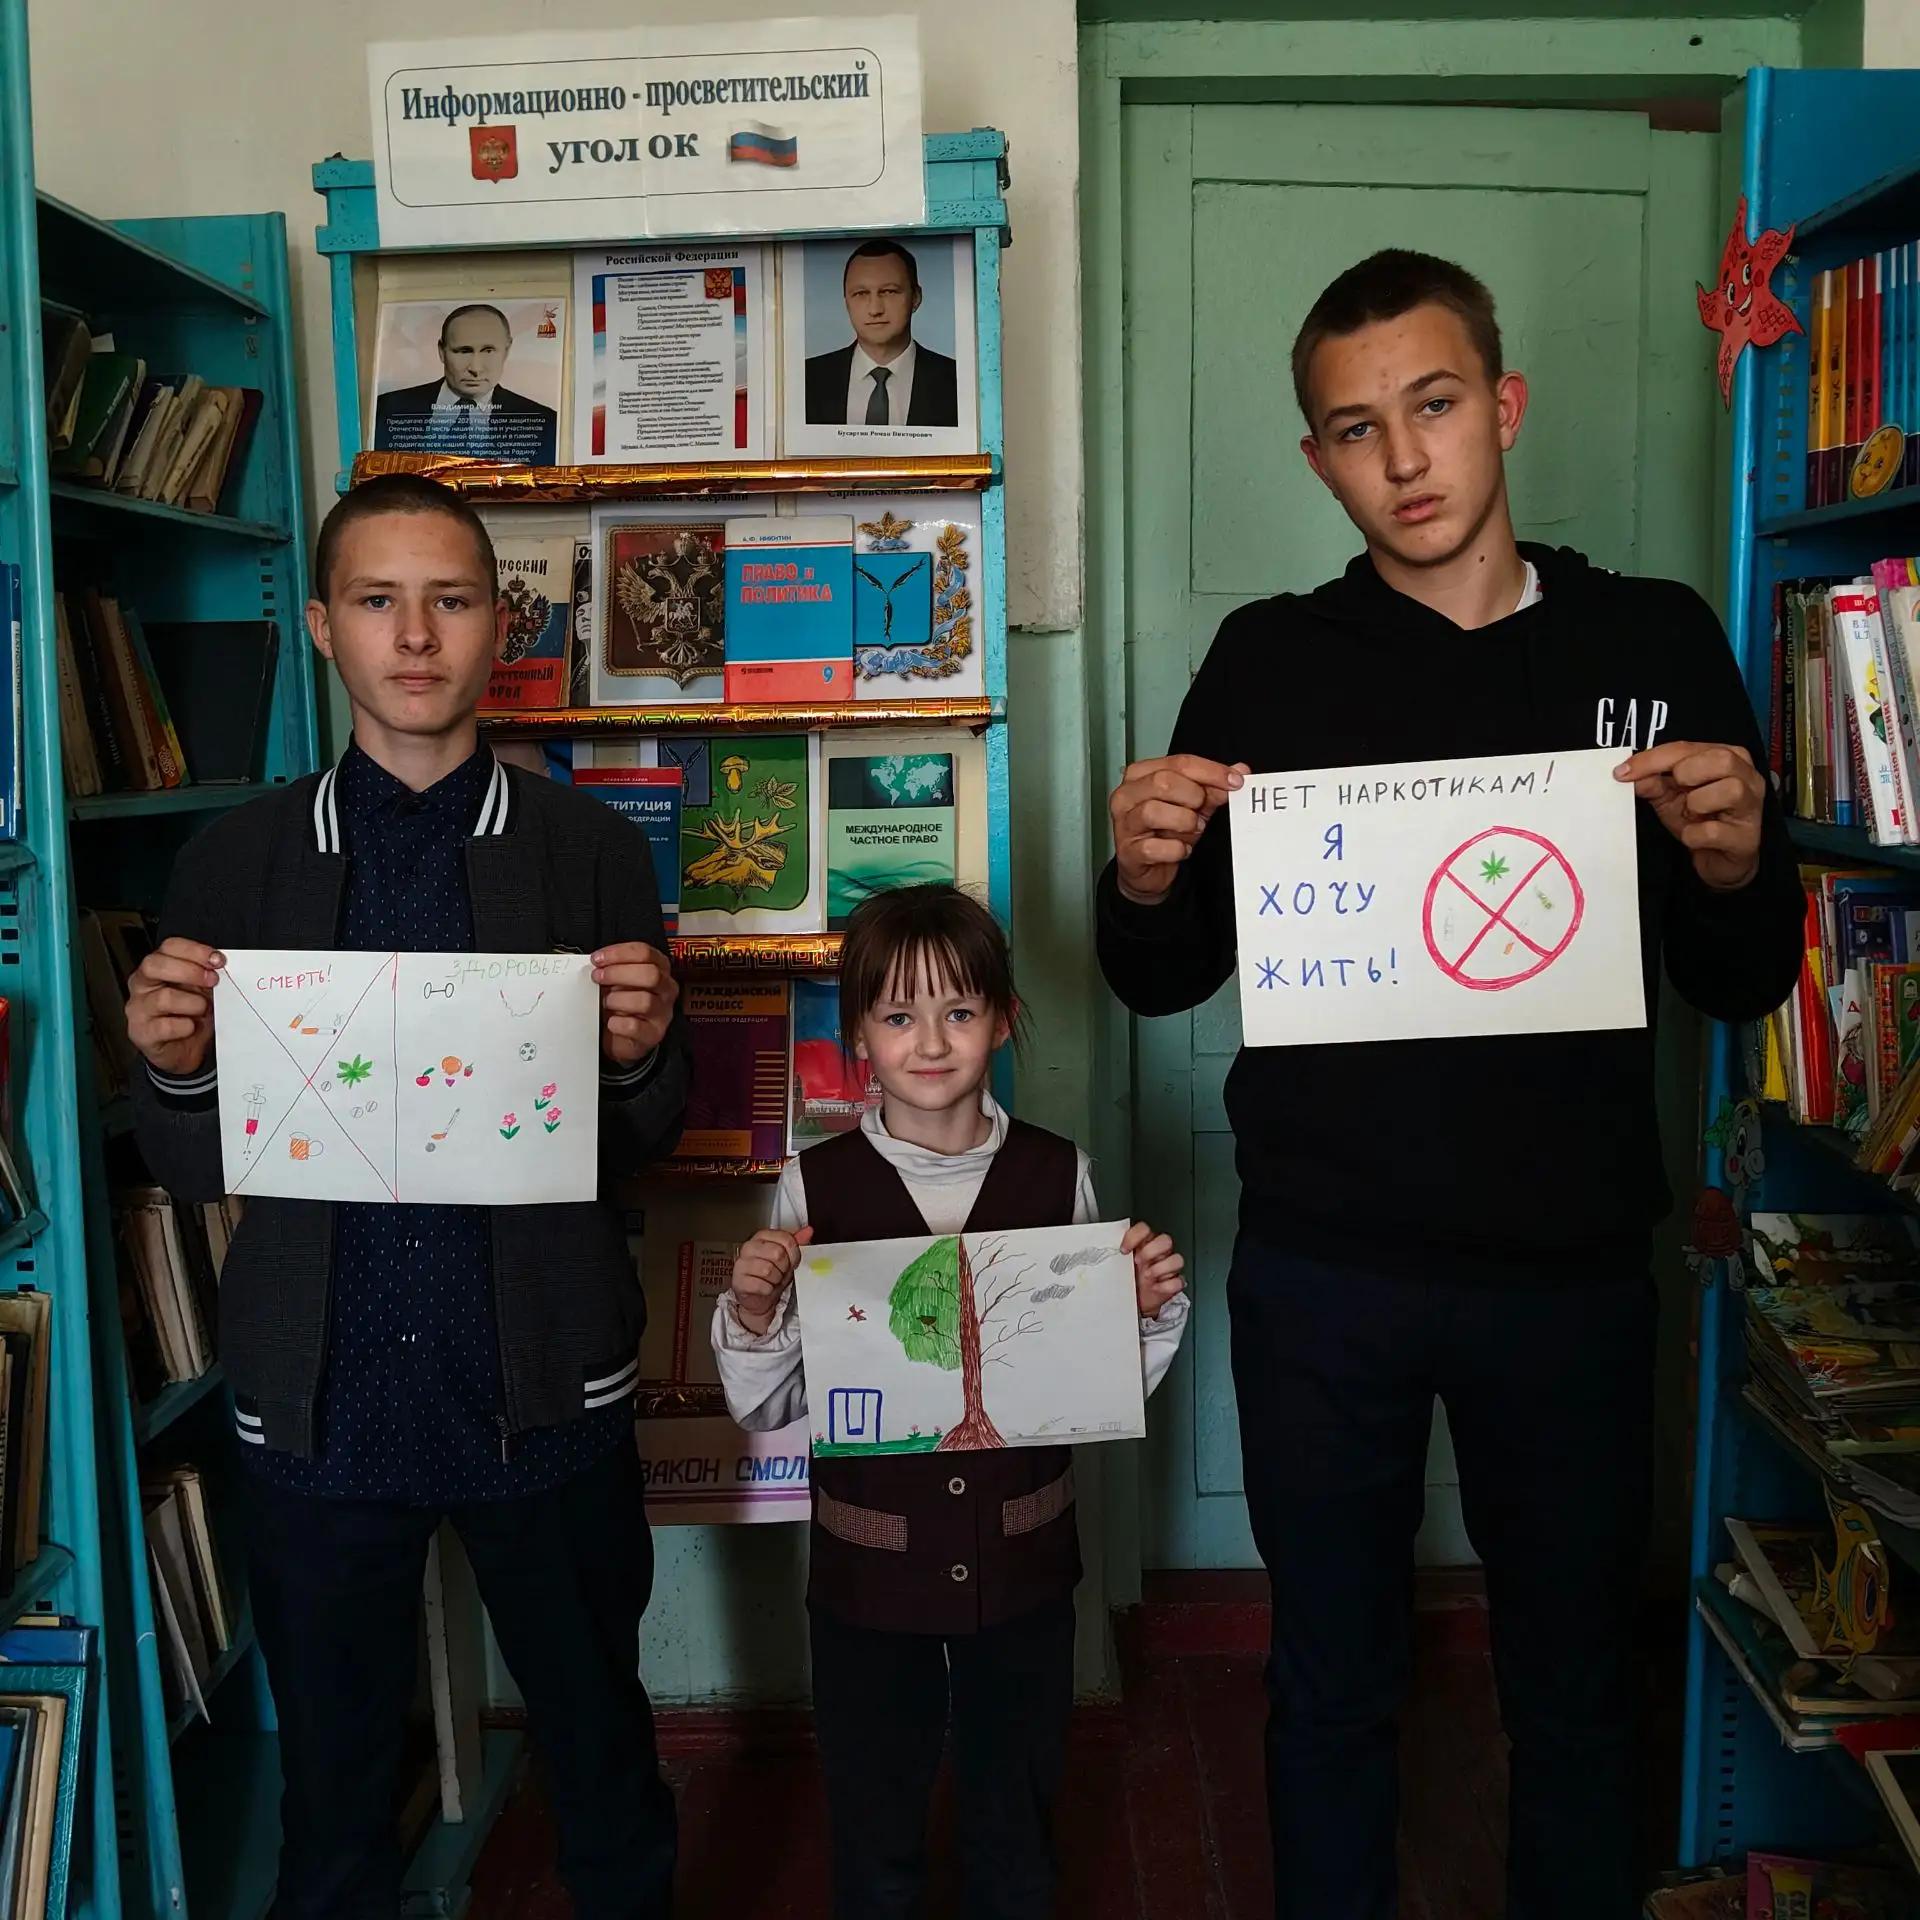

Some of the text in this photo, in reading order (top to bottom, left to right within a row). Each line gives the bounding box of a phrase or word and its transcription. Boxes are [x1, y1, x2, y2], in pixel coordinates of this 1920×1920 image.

[401, 84, 627, 127] Информационно
[645, 60, 870, 116] просветительский
[605, 250, 739, 266] Российской Федерации
[431, 402, 474, 413] Владимир
[496, 558, 548, 576] УССКИЙ
[741, 562, 798, 582] ПРАВО
[740, 583, 833, 604] ПОЛИТИКА
[821, 665, 836, 684] 9
[1595, 697, 1669, 750] GAP
[1250, 760, 1556, 814] НЕТ НАРКОТИКАМ!
[845, 822, 943, 836] МЕЖДУНАРОДНОЕ
[849, 832, 939, 846] ЧАСТНОЕ ПРАВО
[1321, 823, 1345, 861] Я
[1257, 881, 1377, 916] ХОЧУ
[256, 963, 334, 991] СМЕРТЬ!
[444, 957, 572, 984] ЗДОРОВЬЕ!
[1254, 947, 1400, 990] ЖИТЬ!
[690, 984, 782, 998] ГРАЖДАНСКИЙ
[690, 1000, 744, 1011] ПРОЦЕСС
[734, 1455, 809, 1483] СМОЛ
